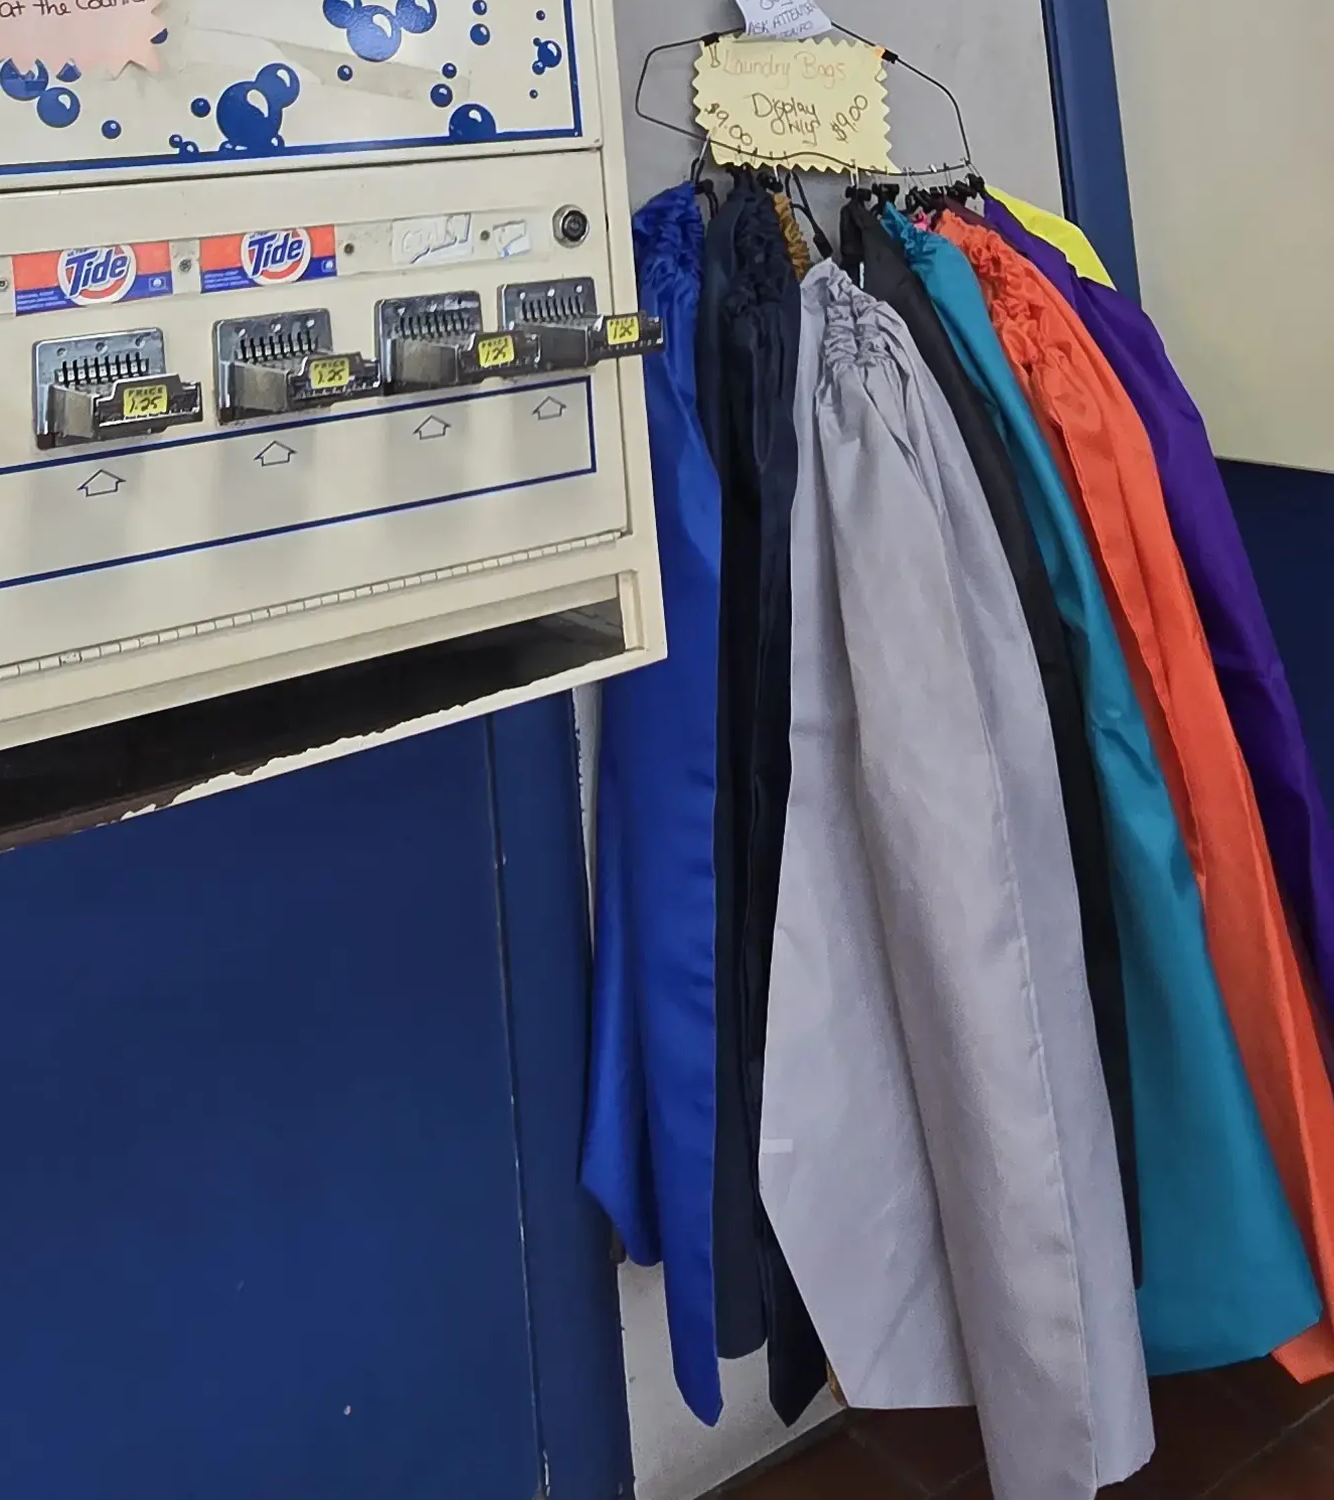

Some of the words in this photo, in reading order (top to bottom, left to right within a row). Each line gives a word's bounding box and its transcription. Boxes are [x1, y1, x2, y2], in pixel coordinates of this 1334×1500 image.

[723, 50, 791, 85] Laundry
[794, 51, 847, 89] Bags
[750, 92, 818, 121] Display
[830, 94, 869, 143] $9.00
[65, 250, 129, 297] Tide
[247, 232, 304, 277] Tide
[312, 359, 346, 370] PRICE
[125, 386, 164, 398] PRICE
